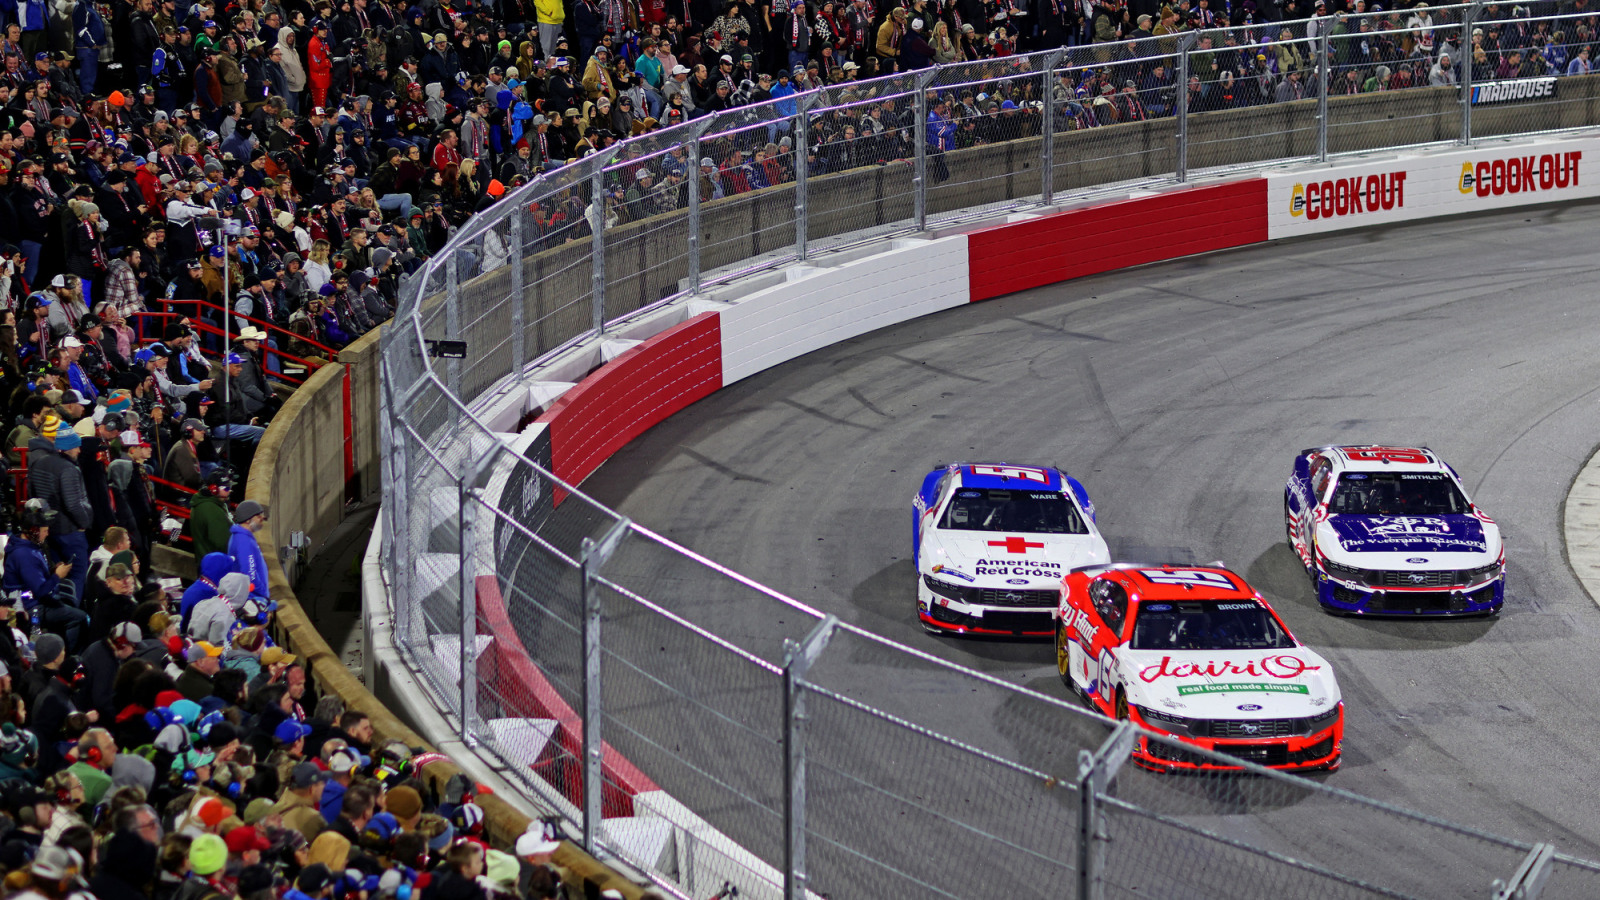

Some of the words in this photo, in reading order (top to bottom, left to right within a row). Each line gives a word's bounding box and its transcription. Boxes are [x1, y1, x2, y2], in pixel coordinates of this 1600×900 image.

[1477, 81, 1553, 102] MADHOUSE
[976, 559, 1061, 569] American
[976, 566, 1008, 575] Red
[1012, 567, 1062, 578] Cross
[1345, 580, 1357, 590] 66
[1217, 603, 1256, 611] BROWN
[1072, 608, 1100, 645] Hunt
[1181, 685, 1204, 693] real
[1263, 684, 1300, 692] simple
